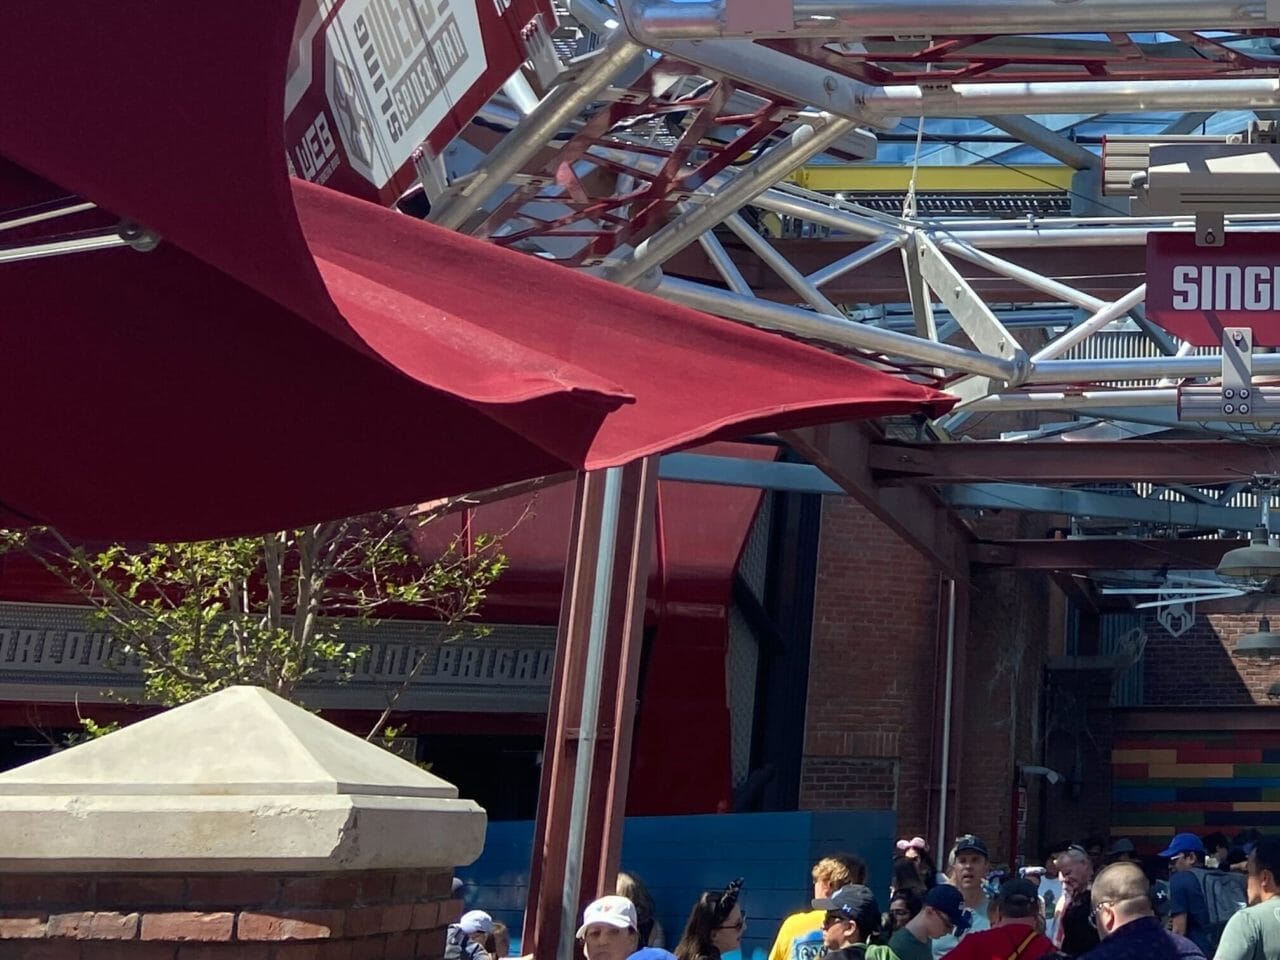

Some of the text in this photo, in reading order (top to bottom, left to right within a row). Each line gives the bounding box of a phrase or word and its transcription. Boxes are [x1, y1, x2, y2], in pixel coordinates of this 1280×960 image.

[354, 13, 402, 143] SLING
[398, 25, 467, 129] SPIDER-MAN
[295, 111, 336, 180] WEB
[437, 646, 556, 680] BRIGAD
